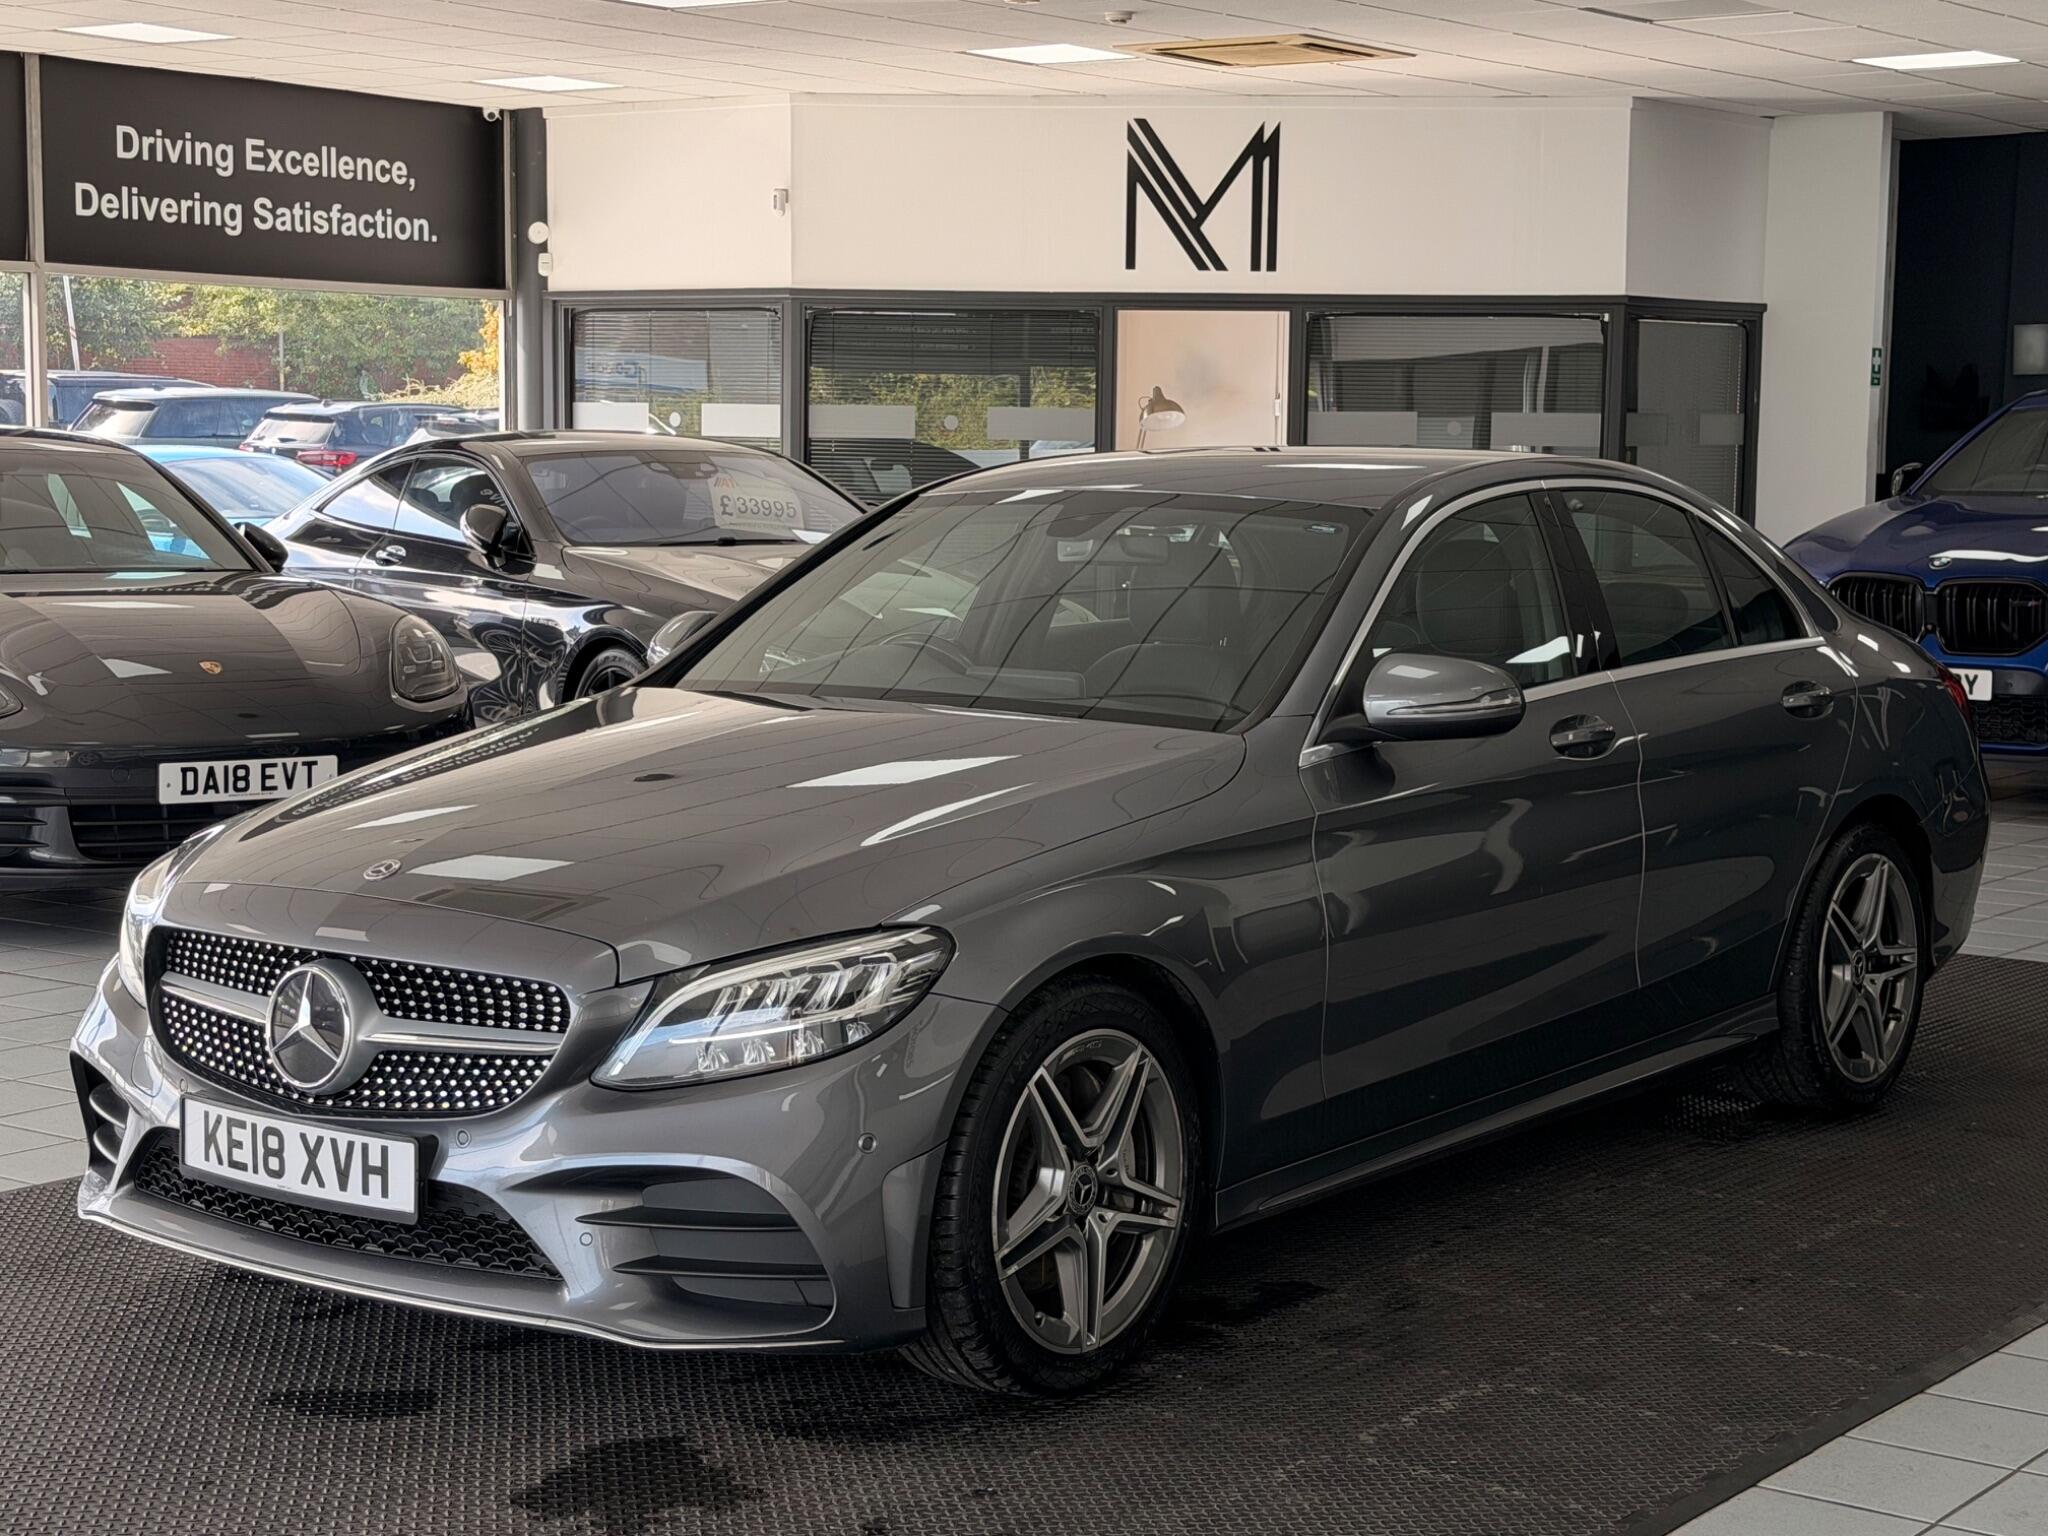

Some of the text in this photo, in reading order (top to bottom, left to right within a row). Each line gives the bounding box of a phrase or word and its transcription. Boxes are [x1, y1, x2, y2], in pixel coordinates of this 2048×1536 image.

[115, 125, 416, 191] Driving Excellence,
[75, 182, 438, 243] Delivering Satisfaction.
[180, 760, 319, 796] DA18 EVT
[203, 1110, 389, 1200] KE18 XVH
